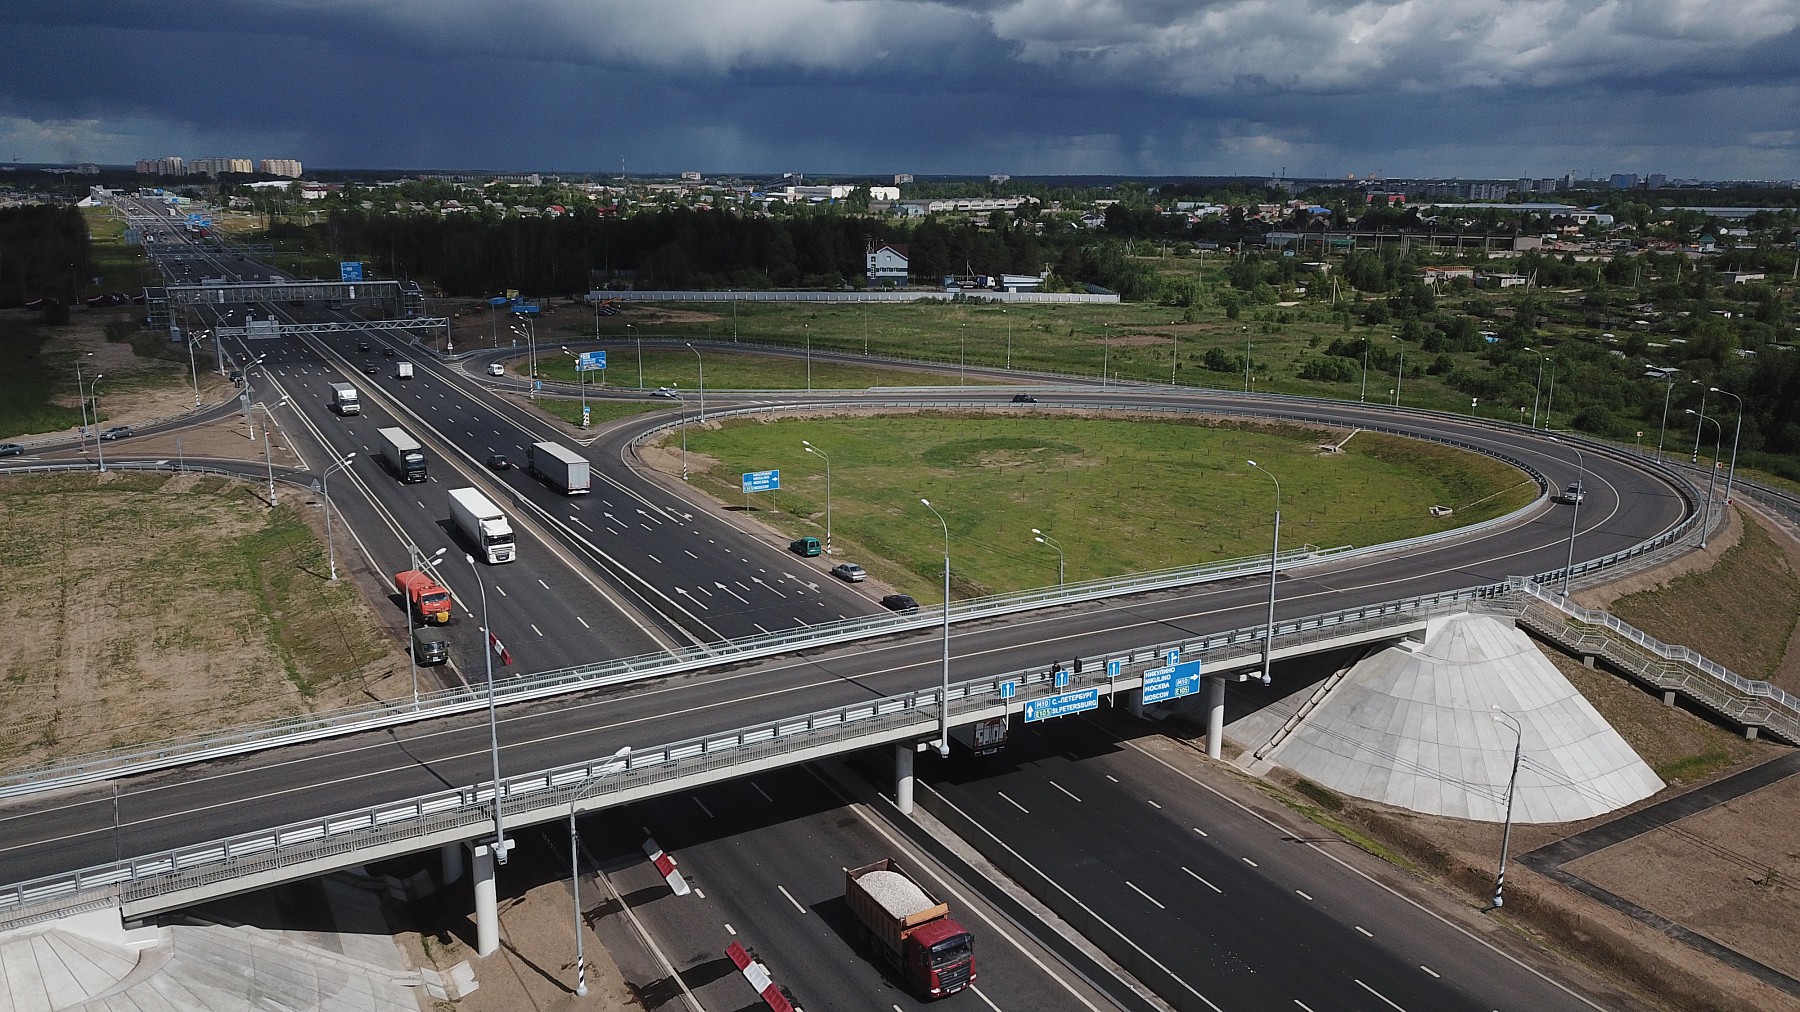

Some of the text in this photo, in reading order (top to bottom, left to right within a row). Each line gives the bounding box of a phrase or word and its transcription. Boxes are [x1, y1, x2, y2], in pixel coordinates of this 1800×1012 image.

[1145, 682, 1170, 692] МОСКВА
[1052, 691, 1094, 705] С.-ПЕТЕРБУРГ
[1144, 691, 1169, 701] MOSCOW
